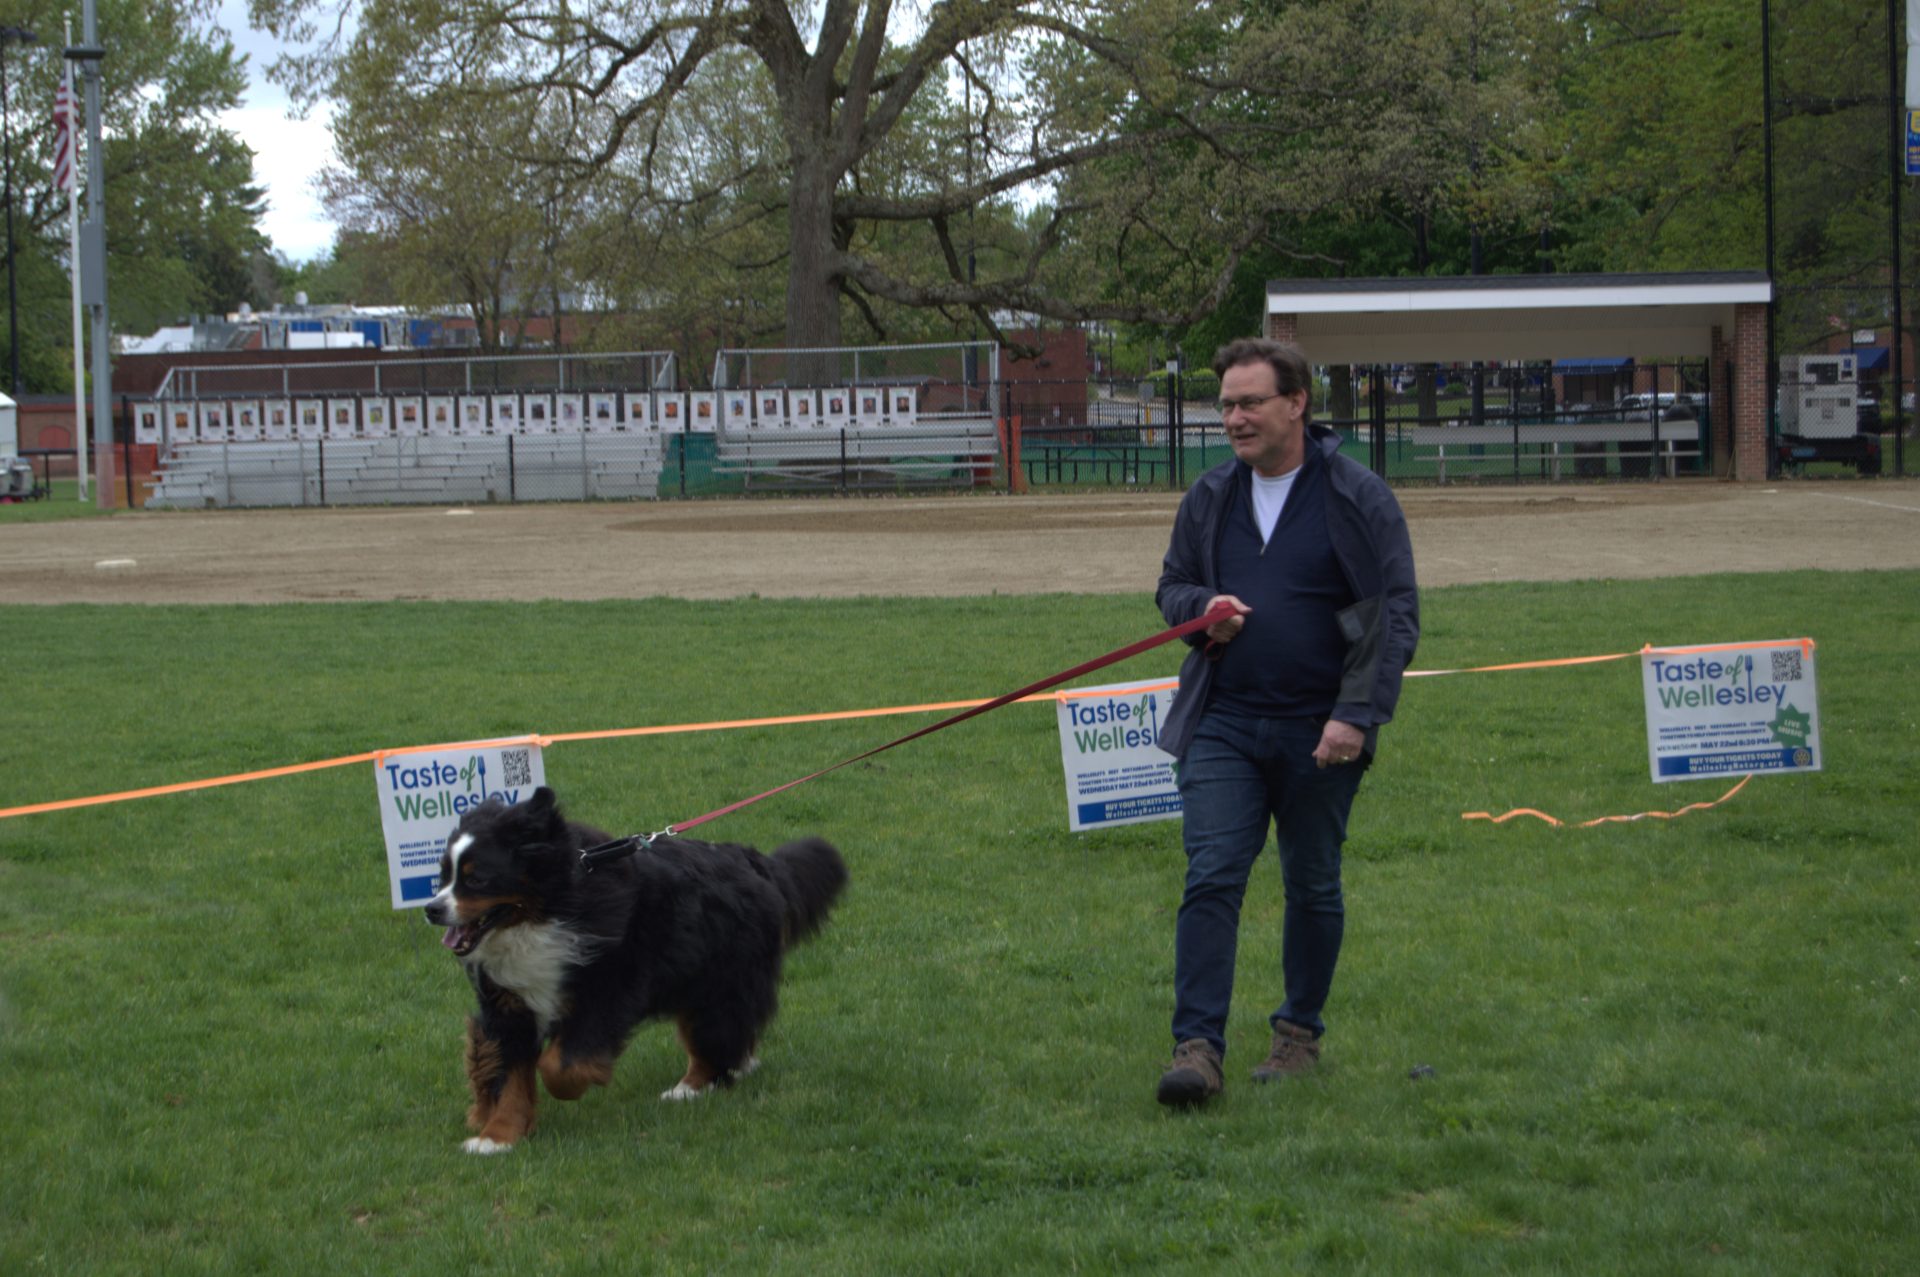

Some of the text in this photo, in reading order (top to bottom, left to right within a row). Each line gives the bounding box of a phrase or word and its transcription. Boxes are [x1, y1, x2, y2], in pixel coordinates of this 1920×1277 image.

[1651, 654, 1744, 686] Taste of
[1658, 684, 1787, 709] Wellesley
[1067, 694, 1148, 726] Taste of
[1783, 719, 1800, 728] LIVE
[1700, 741, 1719, 749] MAY
[1704, 755, 1725, 763] YOUR
[1725, 753, 1756, 762] TICKETS
[1756, 751, 1782, 760] TODAY
[385, 755, 476, 792] Taste of
[1078, 784, 1118, 795] WEDNESDAY
[1119, 781, 1133, 789] MAY
[1134, 779, 1148, 787] 22nd
[1105, 802, 1118, 811] BUY
[1118, 800, 1136, 809] YOUR
[1137, 796, 1162, 806] TICKETS
[401, 856, 440, 868] WEDNESDA
